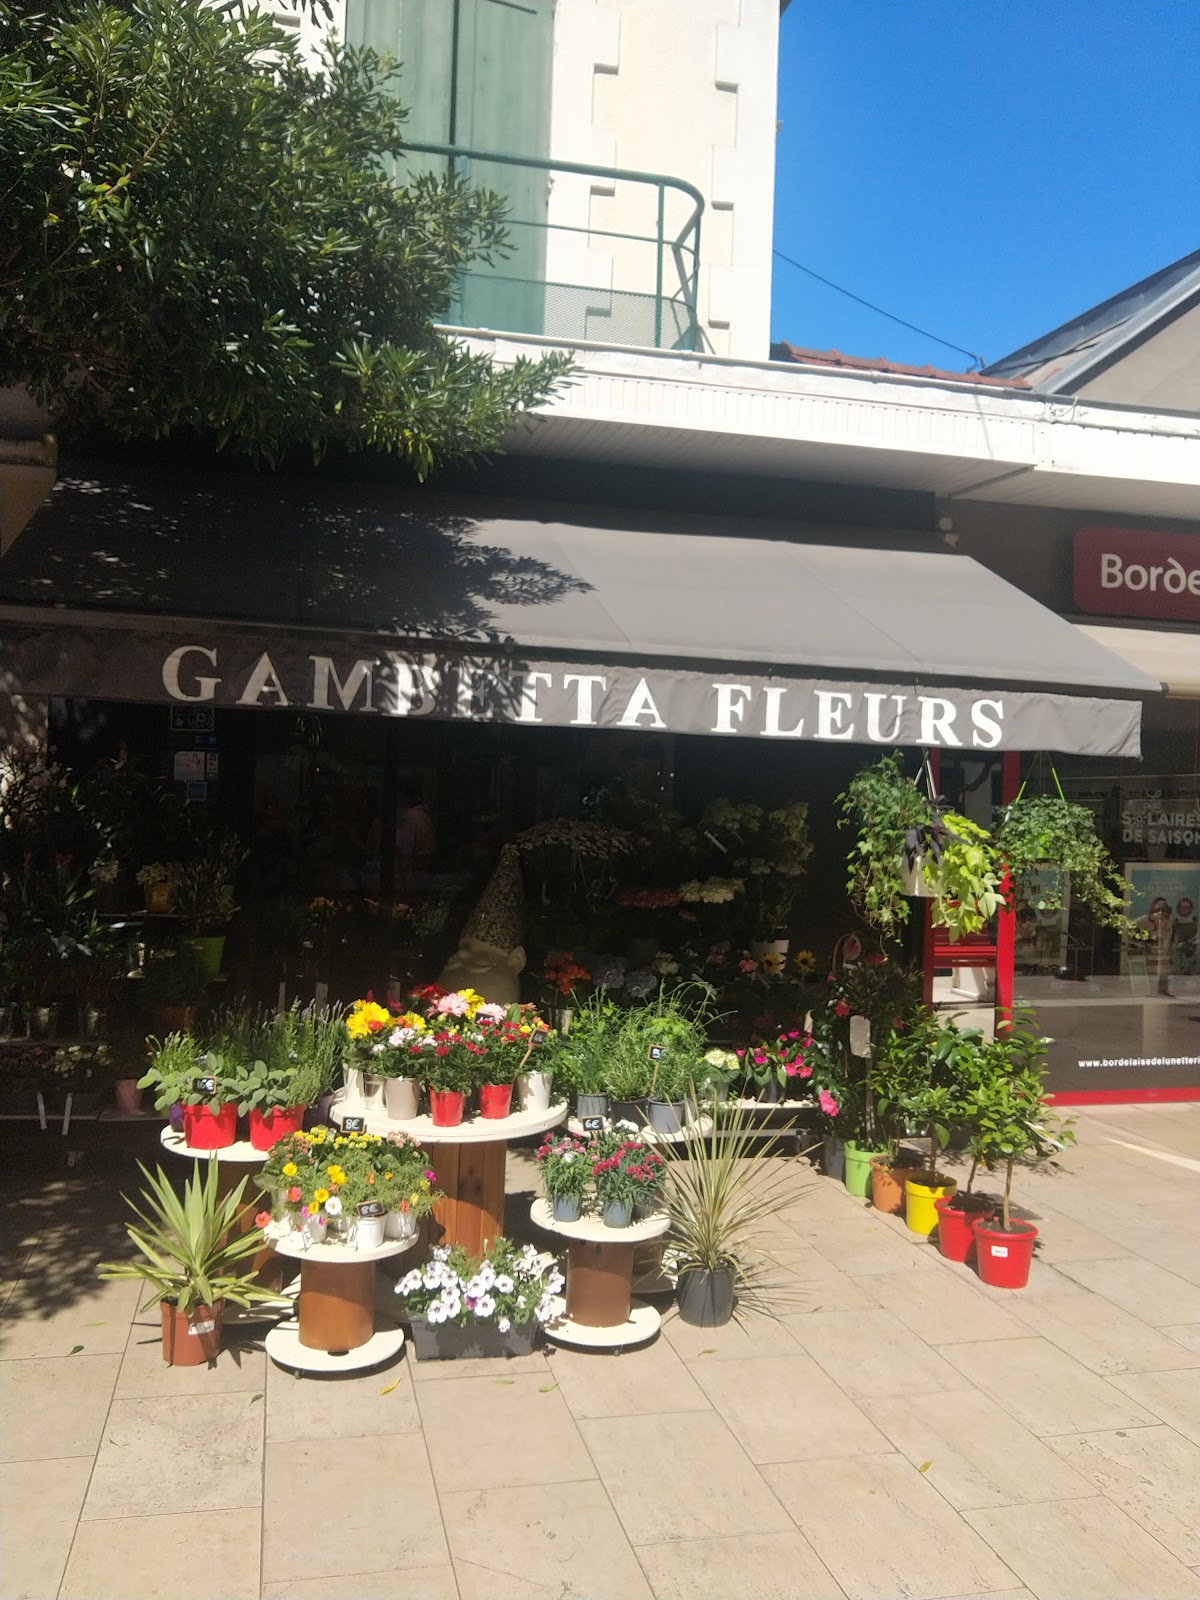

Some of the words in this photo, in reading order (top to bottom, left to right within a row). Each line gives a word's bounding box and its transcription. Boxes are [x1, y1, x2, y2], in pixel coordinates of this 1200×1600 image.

[161, 645, 667, 728] GAMBETTA
[711, 683, 1004, 748] FLEURS
[1123, 829, 1143, 843] DE
[345, 1118, 360, 1130] 8€
[585, 1119, 600, 1129] 6€
